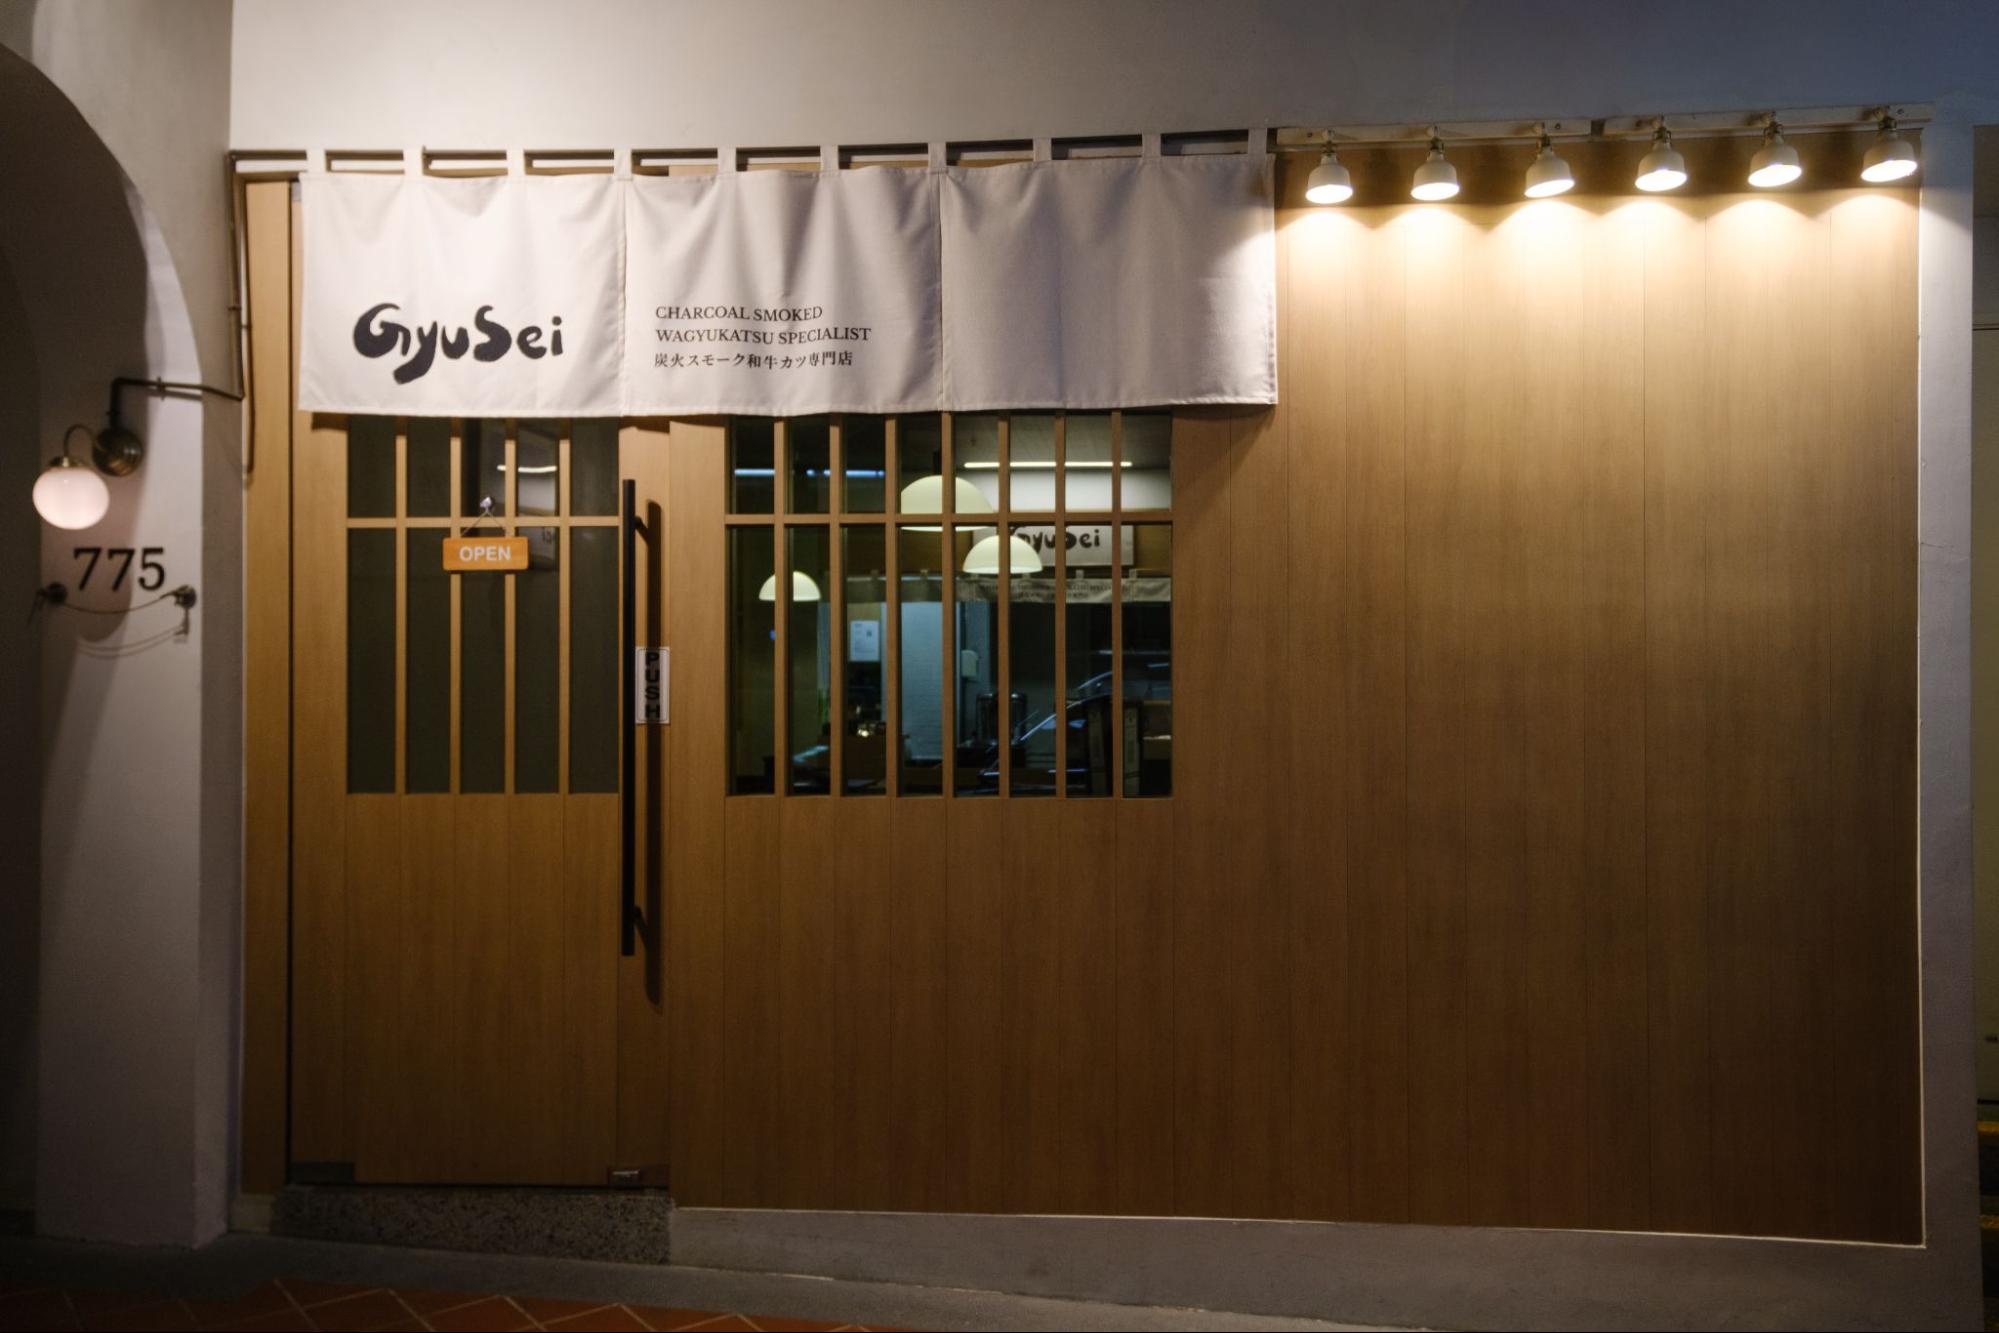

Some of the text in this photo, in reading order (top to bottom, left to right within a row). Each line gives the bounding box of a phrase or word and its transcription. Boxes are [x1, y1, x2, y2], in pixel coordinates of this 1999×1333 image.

[655, 306, 823, 321] CHARCOAL SMOKED
[353, 302, 564, 385] GyuSei
[656, 327, 872, 344] WAGYUKATSU SPECIALIST
[654, 351, 853, 369] 炭火スモーク和牛カツ専門店
[459, 545, 511, 561] OPEN
[73, 547, 165, 591] 775
[645, 652, 660, 718] PUSH
